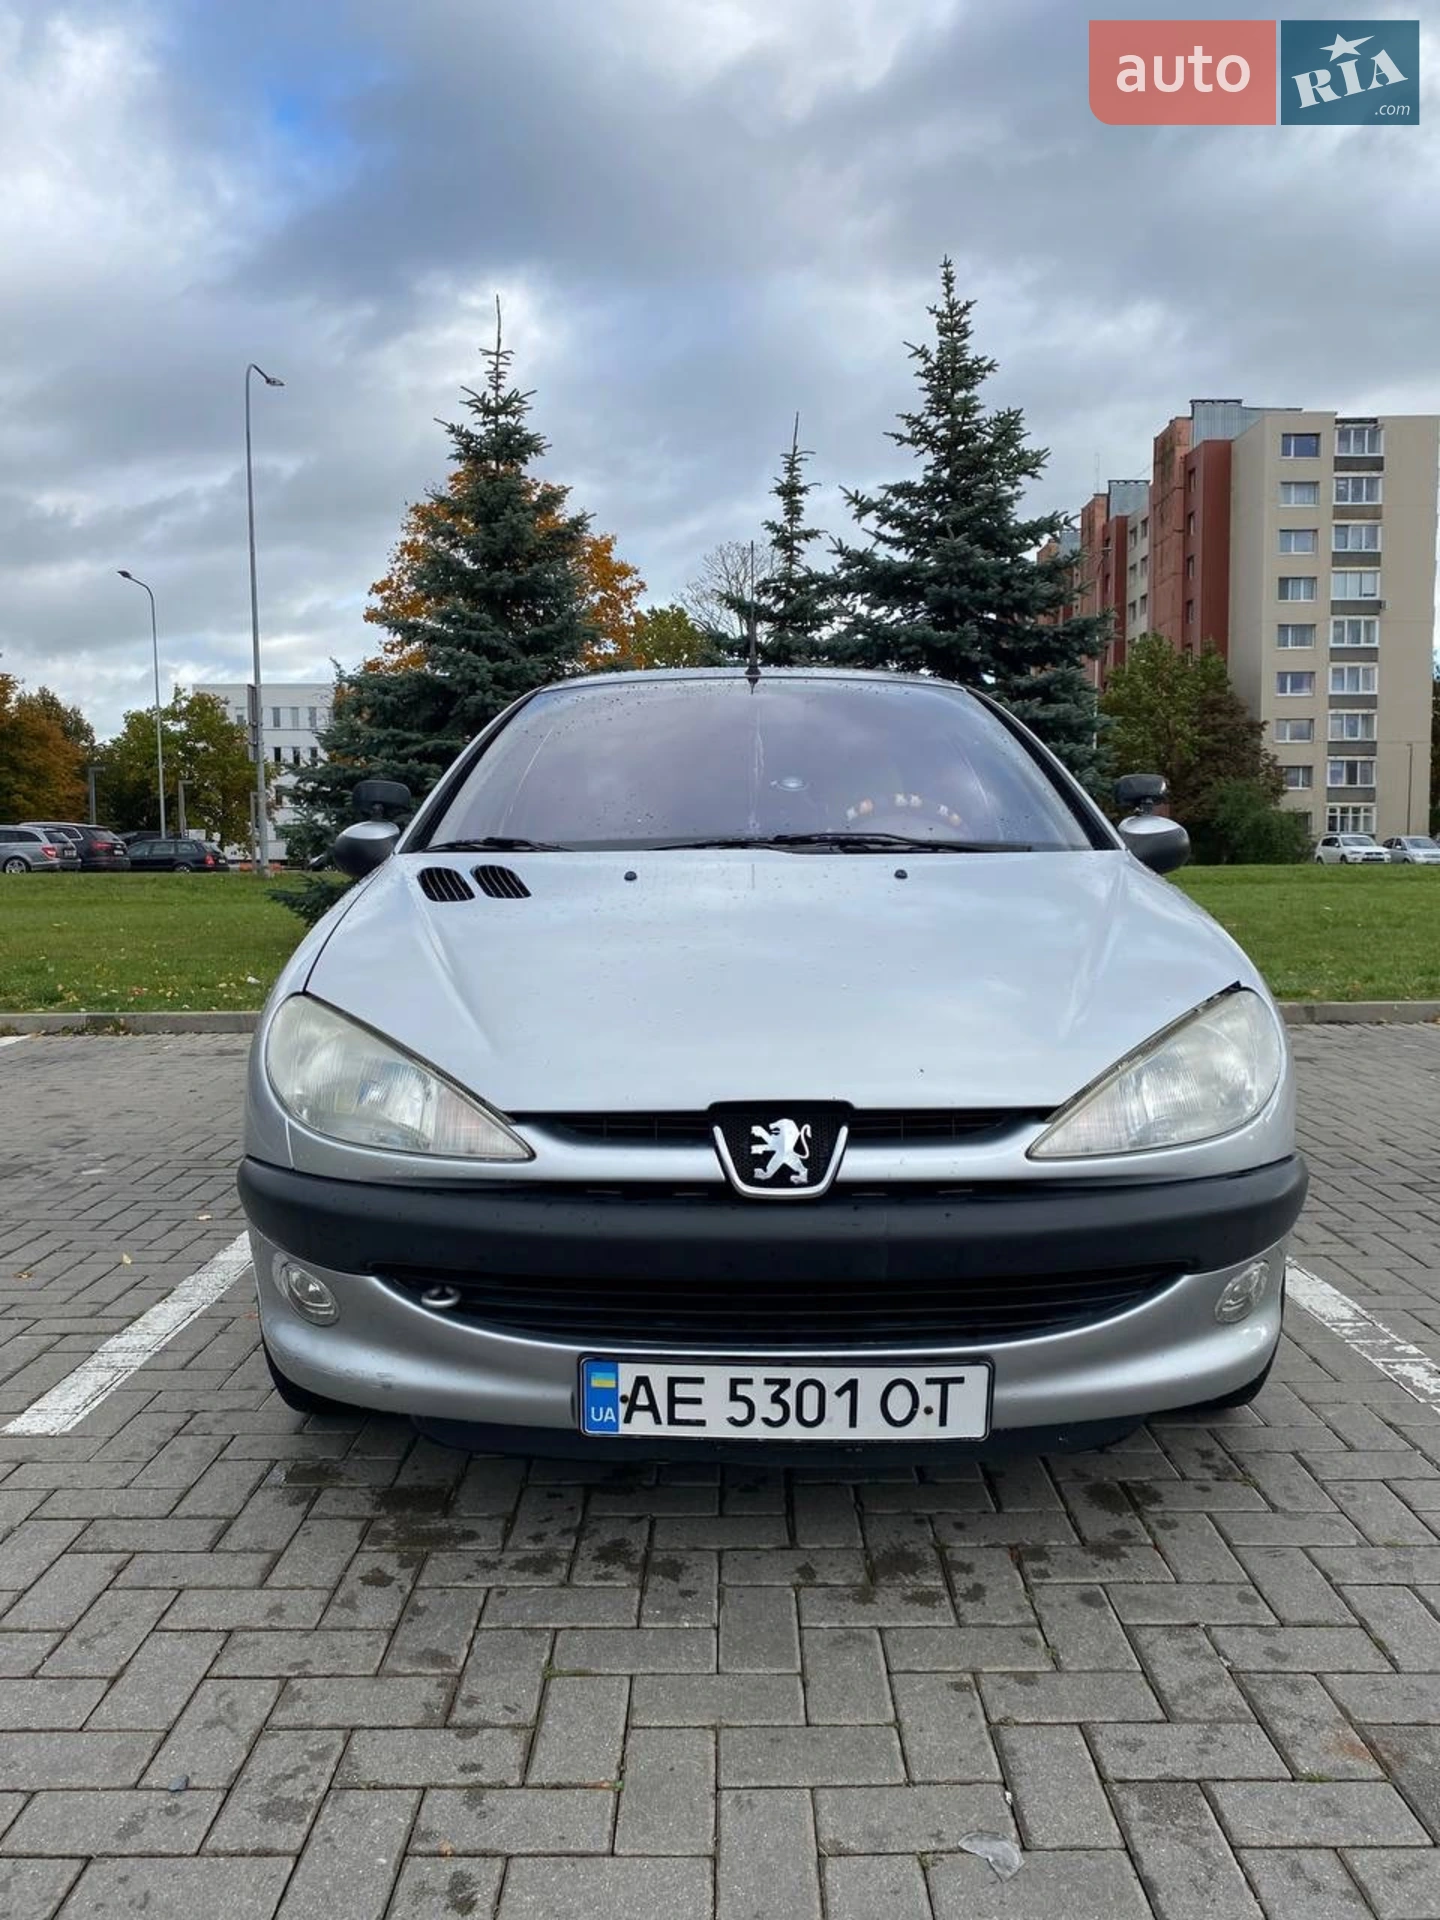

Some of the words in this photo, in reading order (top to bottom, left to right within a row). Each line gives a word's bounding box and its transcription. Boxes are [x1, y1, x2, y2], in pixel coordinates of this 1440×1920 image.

[591, 1407, 616, 1422] UA
[622, 1375, 707, 1427] AE
[726, 1378, 858, 1428] 5301
[880, 1376, 965, 1428] OT
